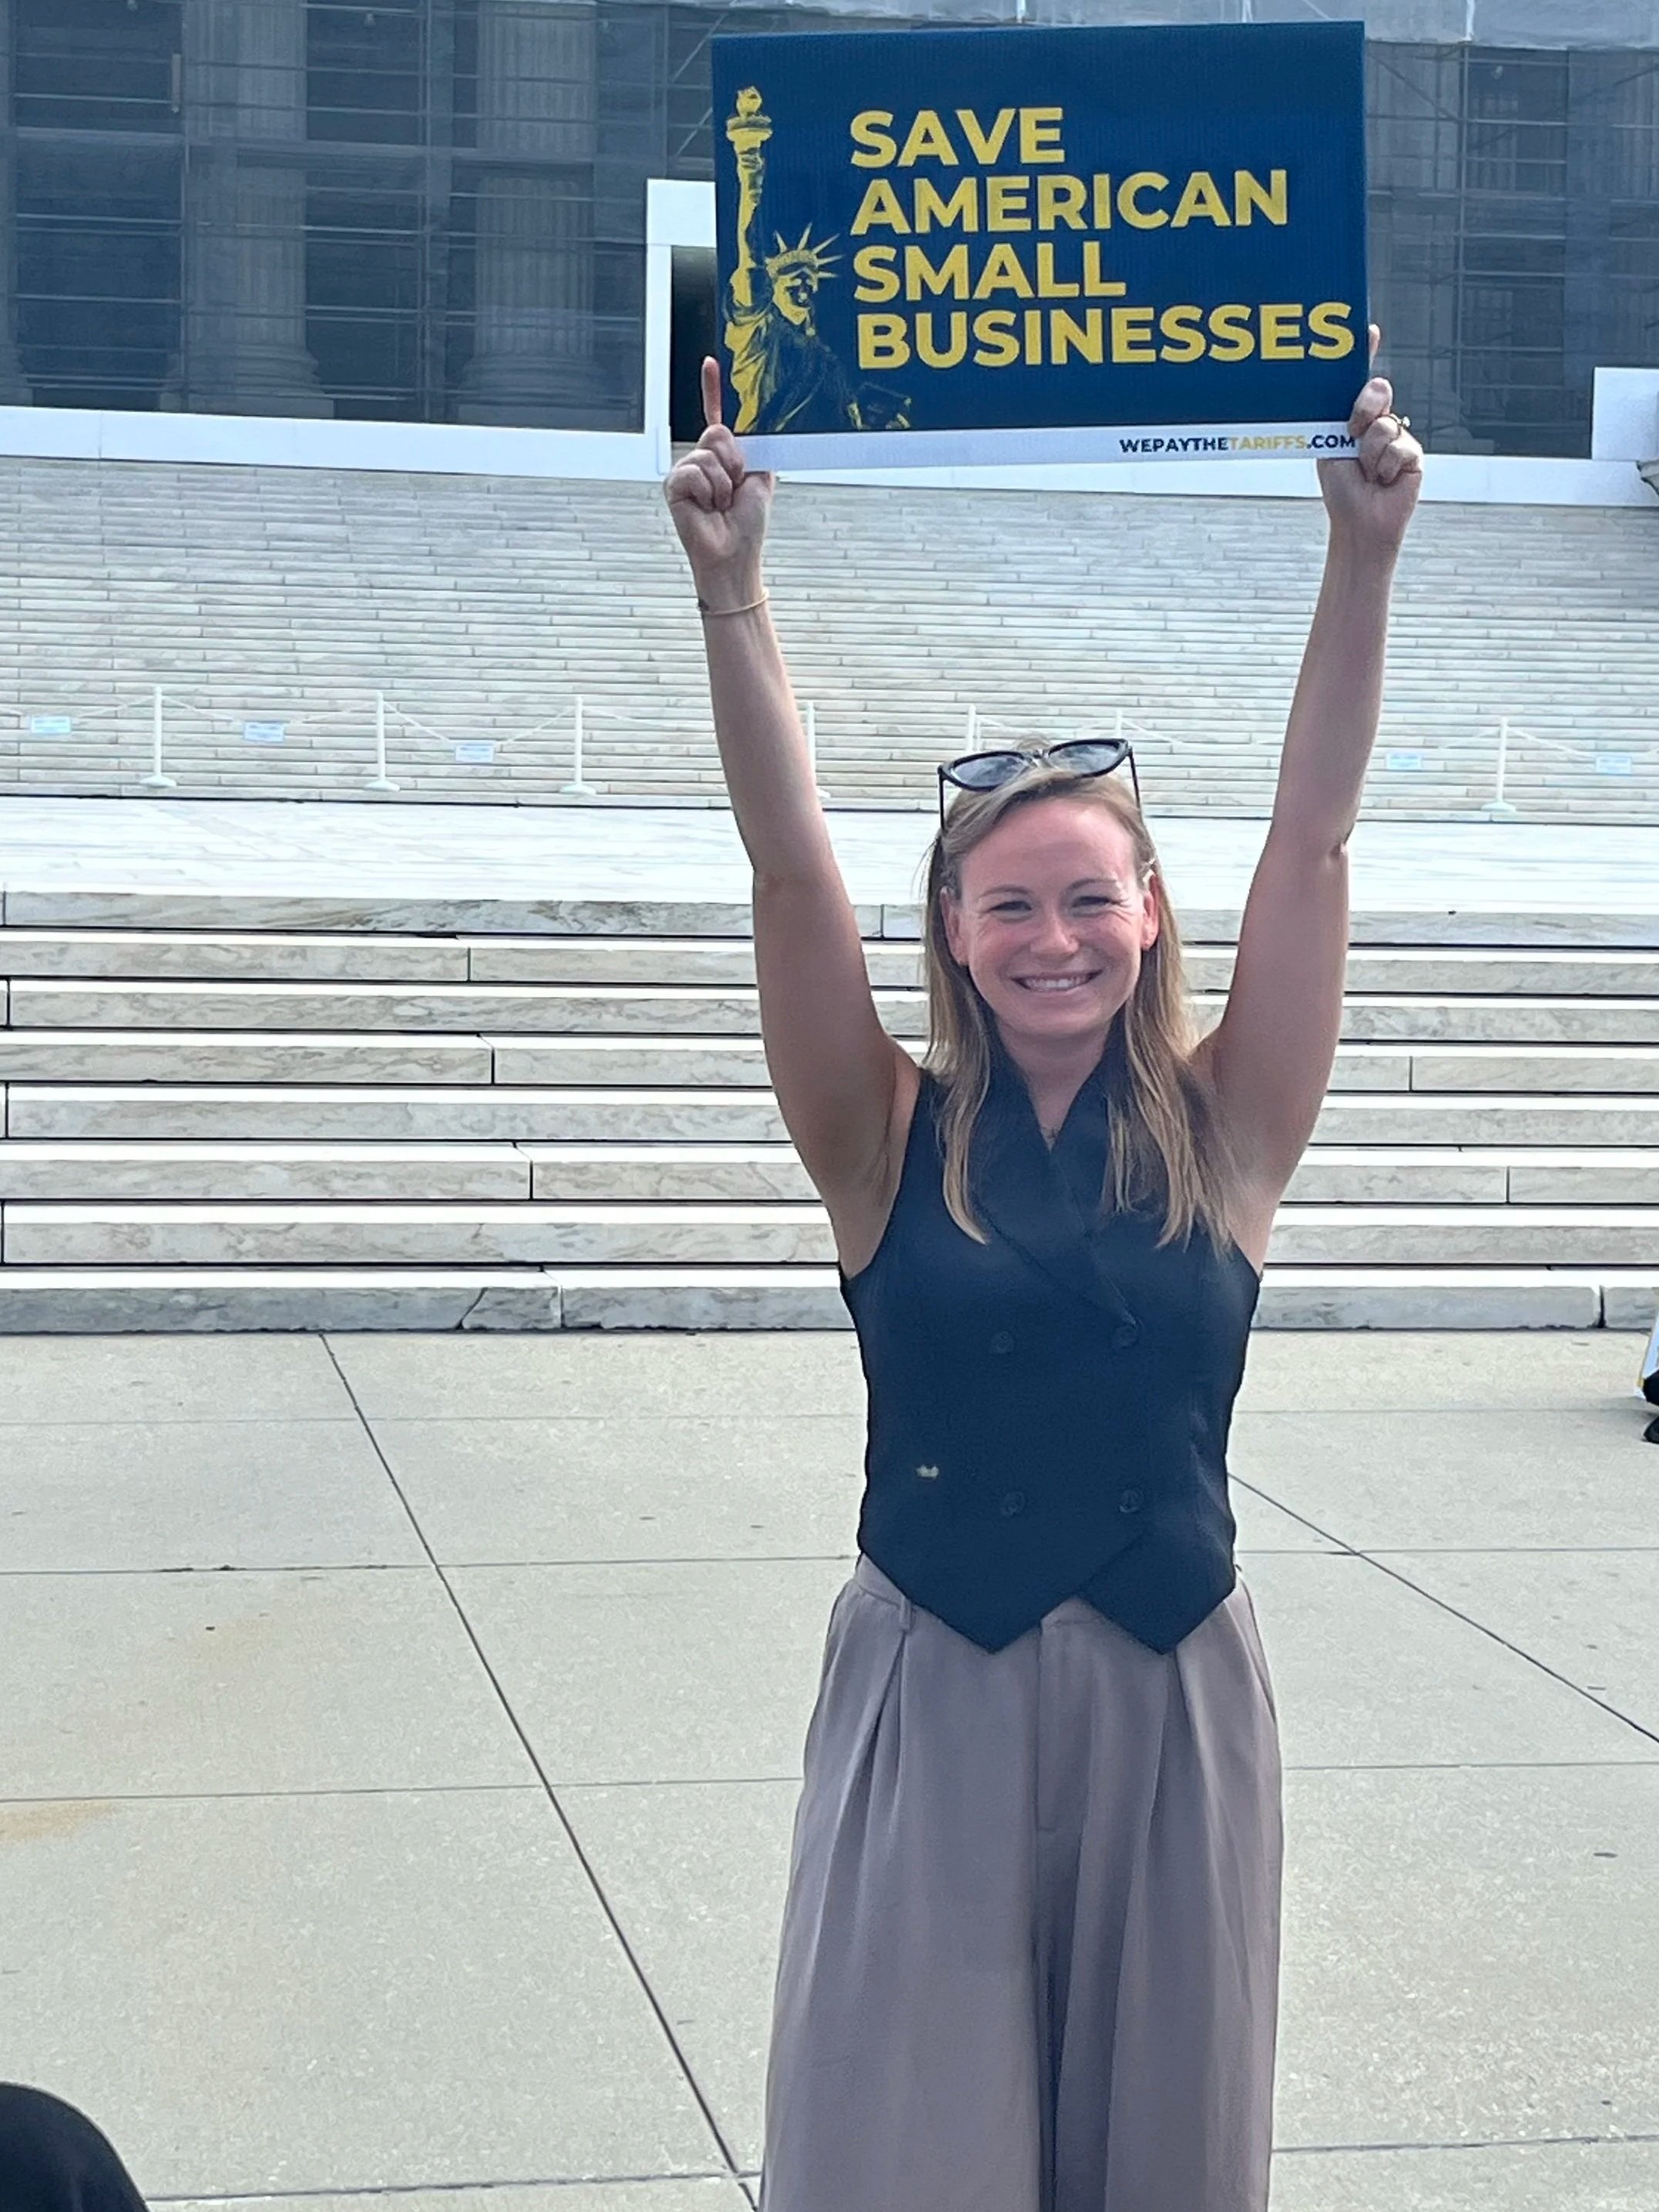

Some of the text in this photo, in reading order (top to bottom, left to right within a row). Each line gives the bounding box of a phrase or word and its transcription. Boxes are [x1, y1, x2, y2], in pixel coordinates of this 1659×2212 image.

[851, 107, 1065, 167] SAVE
[851, 170, 1288, 235] AMERICAN
[854, 241, 1127, 302] SMALL
[858, 303, 1355, 369] BUSINESSES
[1119, 434, 1356, 452] WEPAYTHETARIFFS.COM
